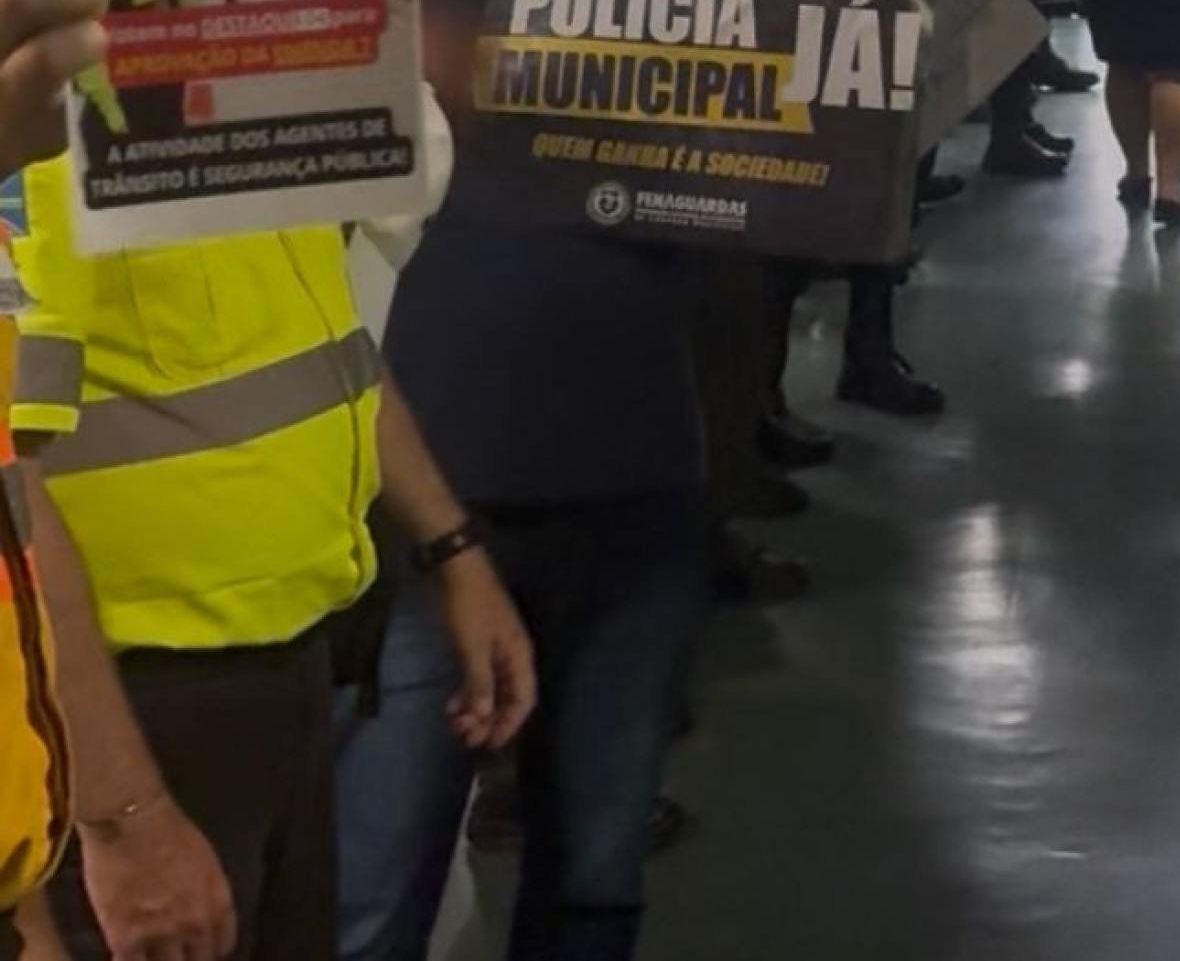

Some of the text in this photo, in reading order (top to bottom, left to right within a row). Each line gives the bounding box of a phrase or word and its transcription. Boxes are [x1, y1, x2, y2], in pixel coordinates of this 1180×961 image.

[494, 48, 783, 122] MUNICIPAL
[107, 117, 387, 164] A ATIVIDADE DOS AGENTES DE
[531, 133, 831, 187] QUEM GANHA É A SOCIEDADE!
[90, 170, 184, 198] TRÂNSITO
[188, 164, 200, 188] É
[203, 156, 318, 186] SEGURANÇA
[635, 190, 747, 216] FENAGUARDAS
